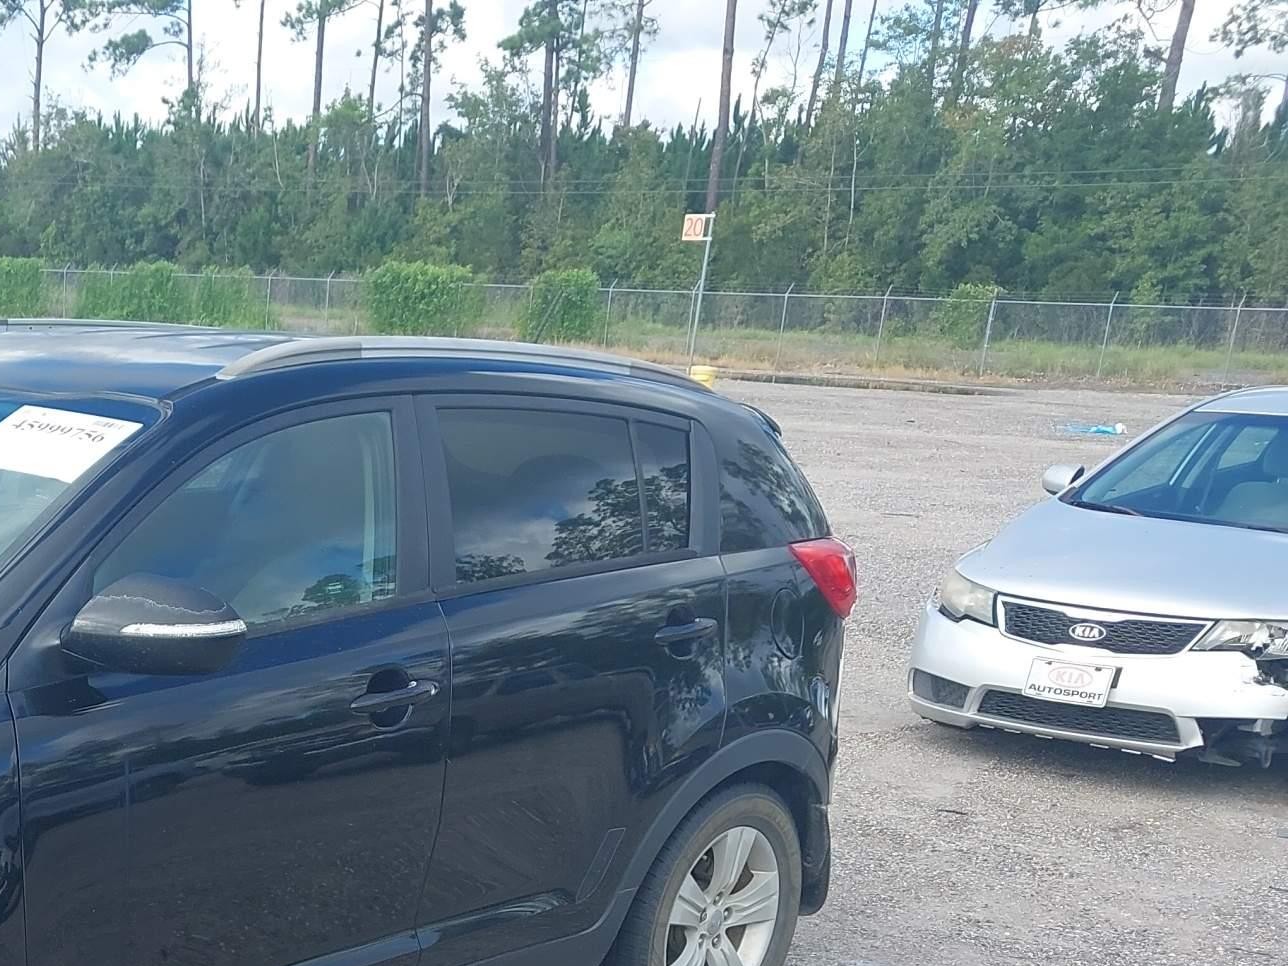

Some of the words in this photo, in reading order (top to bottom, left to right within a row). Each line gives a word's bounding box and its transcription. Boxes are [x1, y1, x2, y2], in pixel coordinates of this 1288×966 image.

[684, 217, 704, 237] 20
[11, 419, 105, 443] 45999756
[1074, 625, 1100, 638] KIA
[1055, 670, 1086, 684] KIA
[1028, 683, 1104, 701] AUTOSPORT
